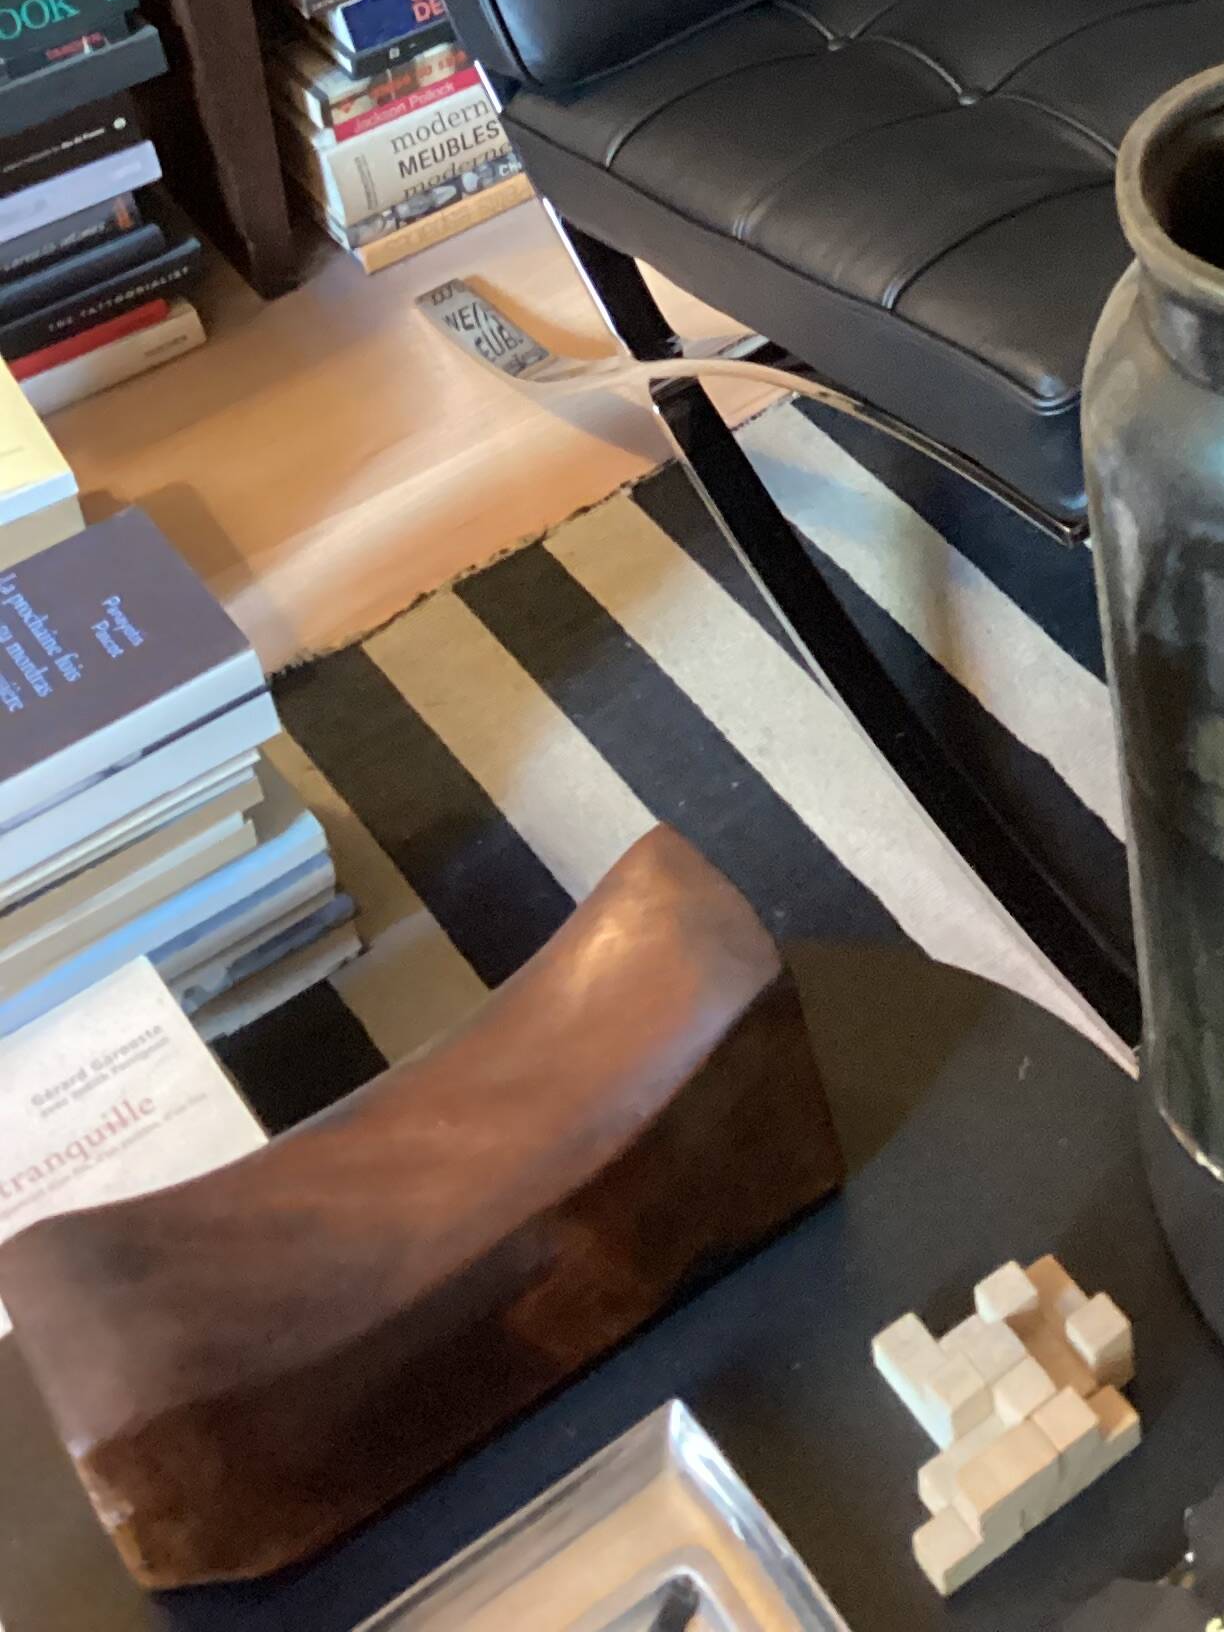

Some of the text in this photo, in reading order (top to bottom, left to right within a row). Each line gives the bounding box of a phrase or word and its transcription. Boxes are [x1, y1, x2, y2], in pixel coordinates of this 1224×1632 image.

[390, 99, 490, 156] modern
[398, 119, 500, 180] MEUBLES
[1, 592, 63, 657] prochaine
[0, 1096, 157, 1199] tranquille
